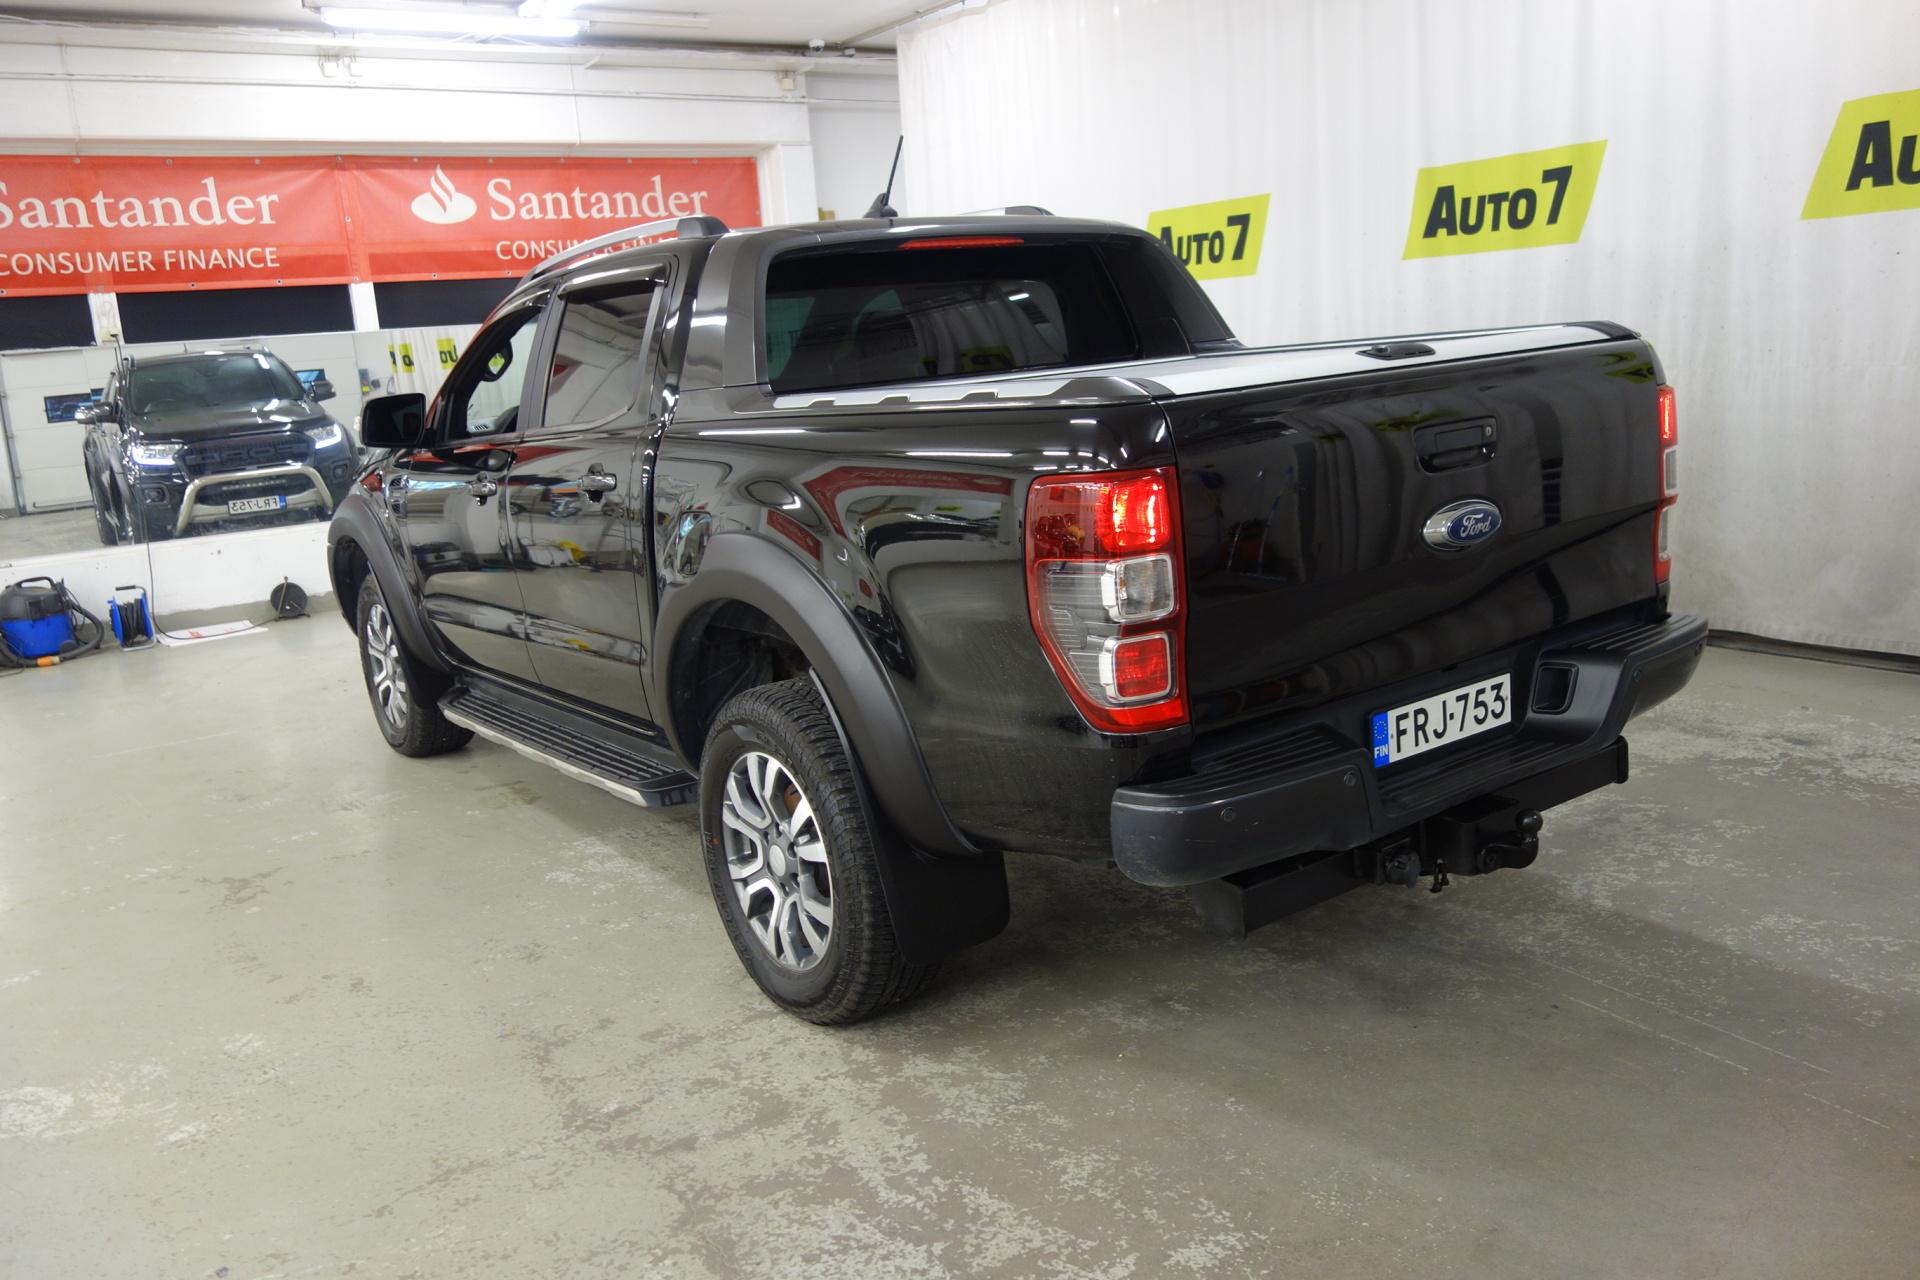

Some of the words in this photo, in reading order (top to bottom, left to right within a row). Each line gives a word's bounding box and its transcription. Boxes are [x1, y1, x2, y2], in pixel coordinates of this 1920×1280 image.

[487, 175, 708, 221] Santander
[164, 247, 281, 271] FINANCE
[1460, 513, 1492, 538] Ford
[1394, 682, 1506, 754] FRJ-753
[1374, 744, 1389, 759] FIN
